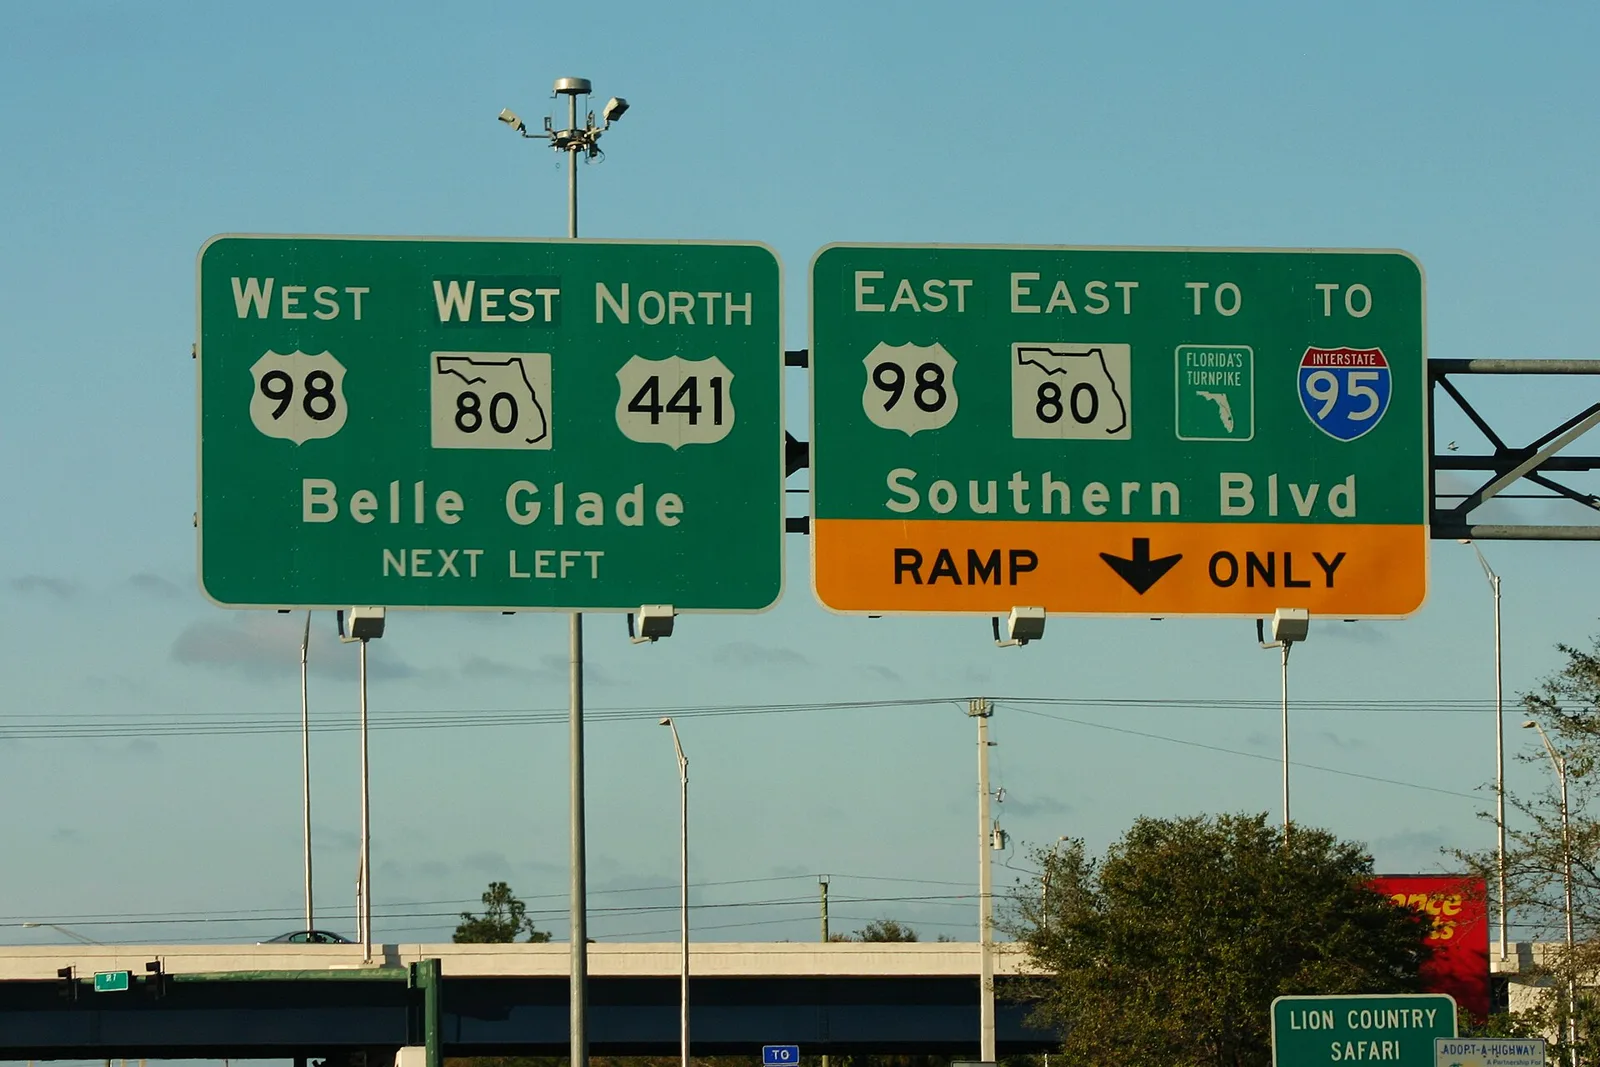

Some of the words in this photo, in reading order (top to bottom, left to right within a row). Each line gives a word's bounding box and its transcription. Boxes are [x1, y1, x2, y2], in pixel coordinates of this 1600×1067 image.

[231, 276, 370, 321] WEST
[432, 280, 560, 322] WEST
[595, 282, 752, 326] NORTH
[854, 270, 973, 313] EAST
[1010, 272, 1139, 314] EAST
[1185, 282, 1242, 316] TO
[1315, 283, 1372, 318] TO
[1186, 352, 1243, 368] FLORIDA'S
[1187, 371, 1242, 386] TURNPIKE
[1312, 353, 1376, 366] INTERSTATE
[260, 369, 337, 421] 98
[627, 375, 723, 426] 441
[872, 361, 947, 412] 98
[1035, 381, 1099, 424] 80
[1305, 370, 1380, 421] 95
[455, 390, 519, 433] 80
[302, 478, 465, 524] Belle
[505, 480, 684, 526] Glade
[885, 467, 1180, 515] Southern
[1219, 472, 1356, 517] Blvd
[383, 548, 484, 578] NEXT
[509, 550, 605, 579] LEFT
[894, 548, 1039, 586] RAMP
[1208, 550, 1346, 588] ONLY
[1290, 1009, 1335, 1030] LION
[1347, 1008, 1437, 1030] COUNTRY
[772, 1049, 790, 1060] TO
[1331, 1040, 1400, 1061] SAFARI
[1443, 1044, 1536, 1056] ADOPT-A-HIGHWAY
